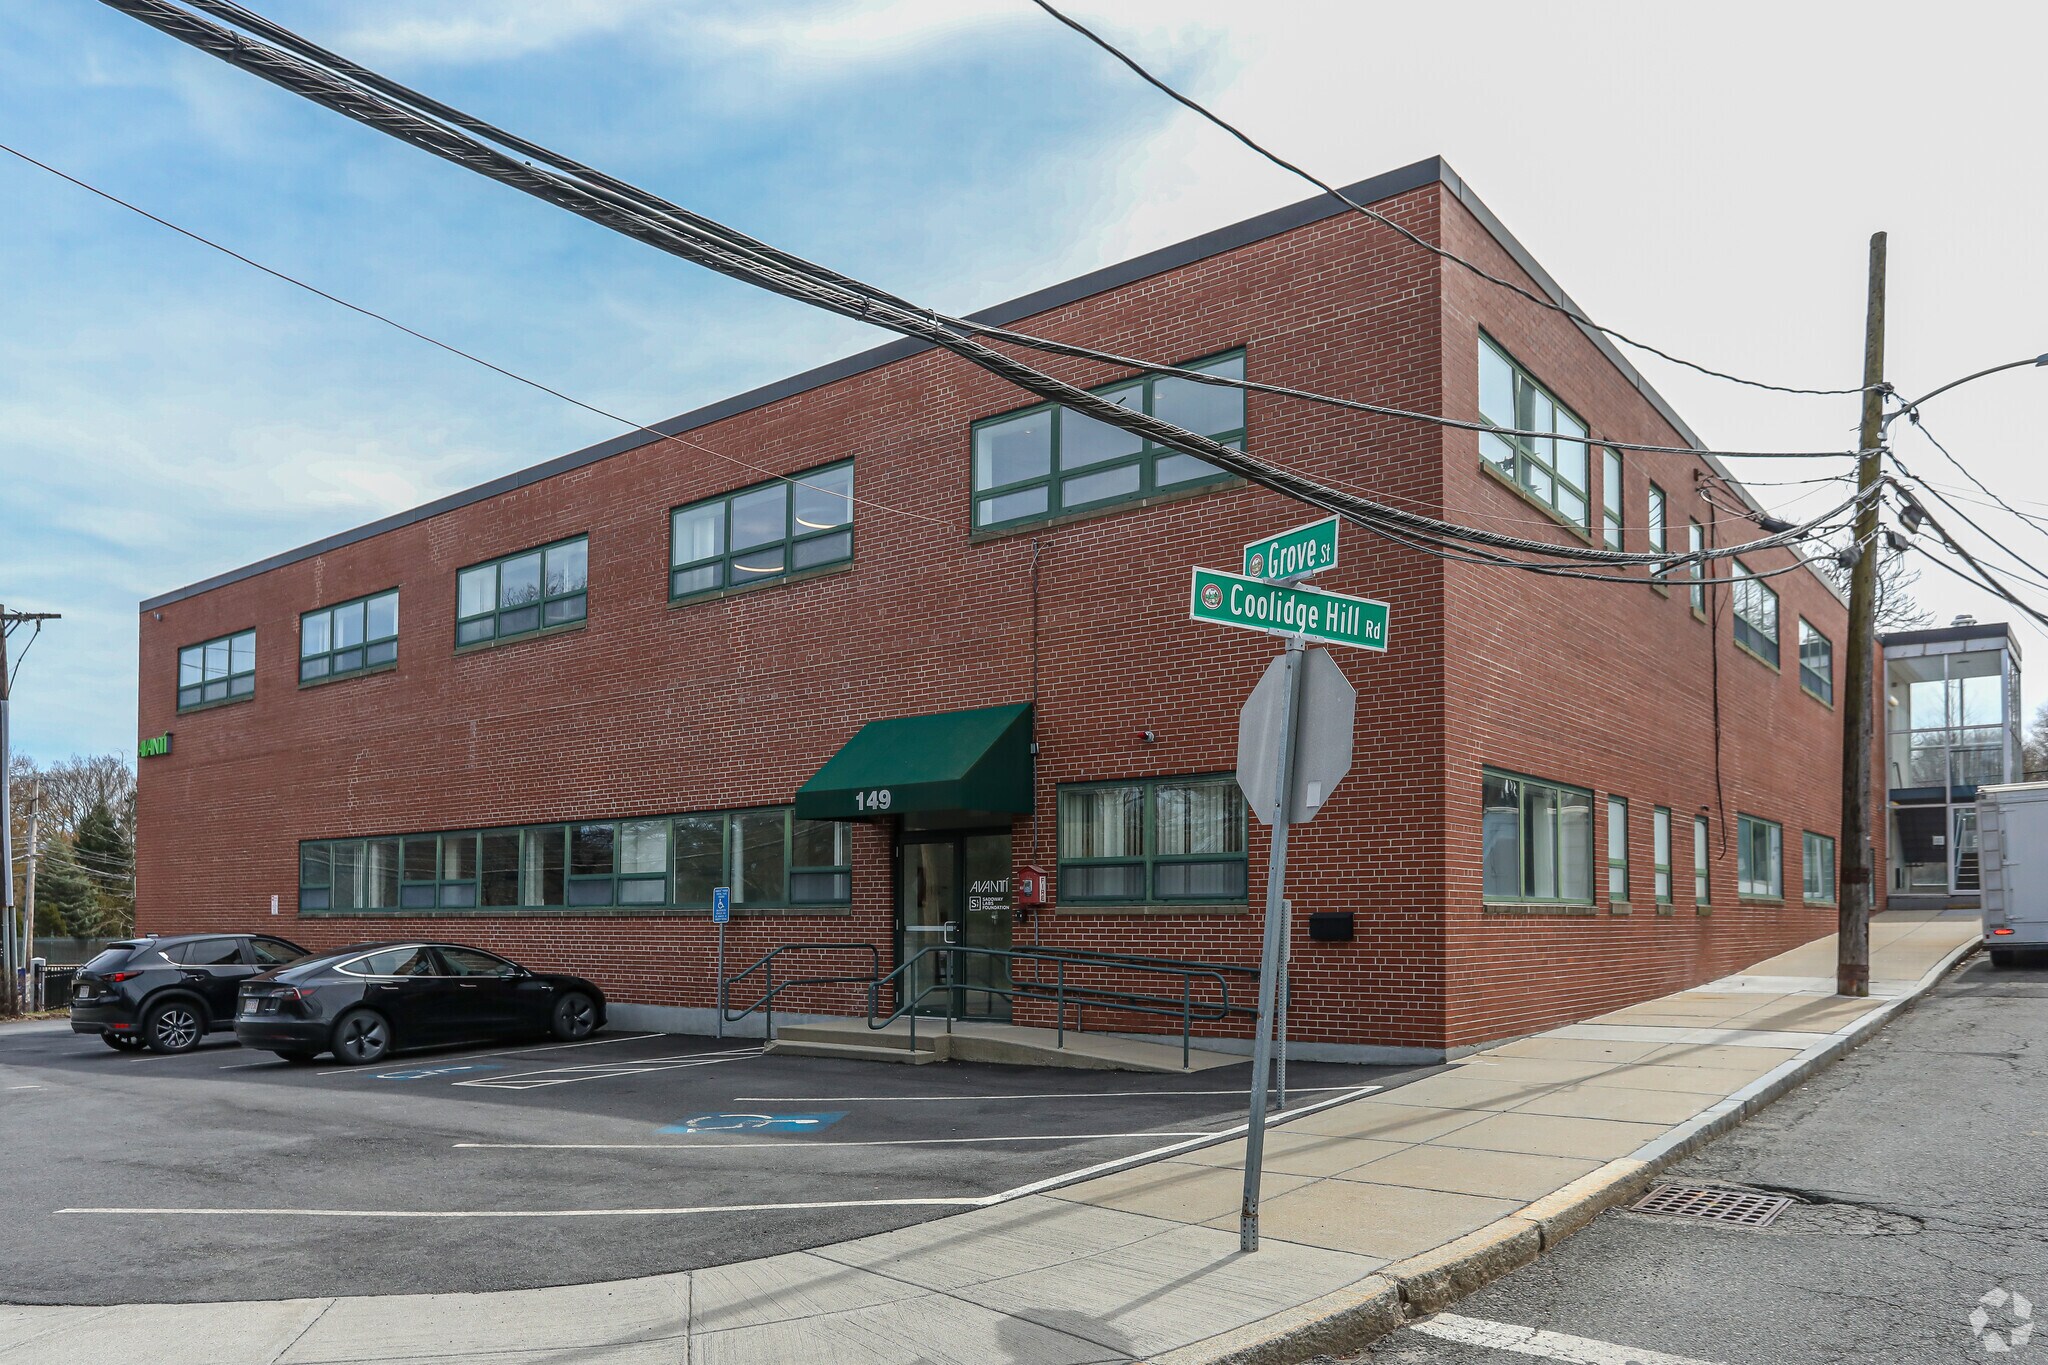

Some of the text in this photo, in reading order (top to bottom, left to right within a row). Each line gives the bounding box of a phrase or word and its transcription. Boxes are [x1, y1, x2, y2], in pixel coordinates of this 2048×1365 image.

[1268, 539, 1331, 578] Grove St
[1230, 583, 1381, 640] Coolidge Hill Rd
[855, 789, 892, 811] 149
